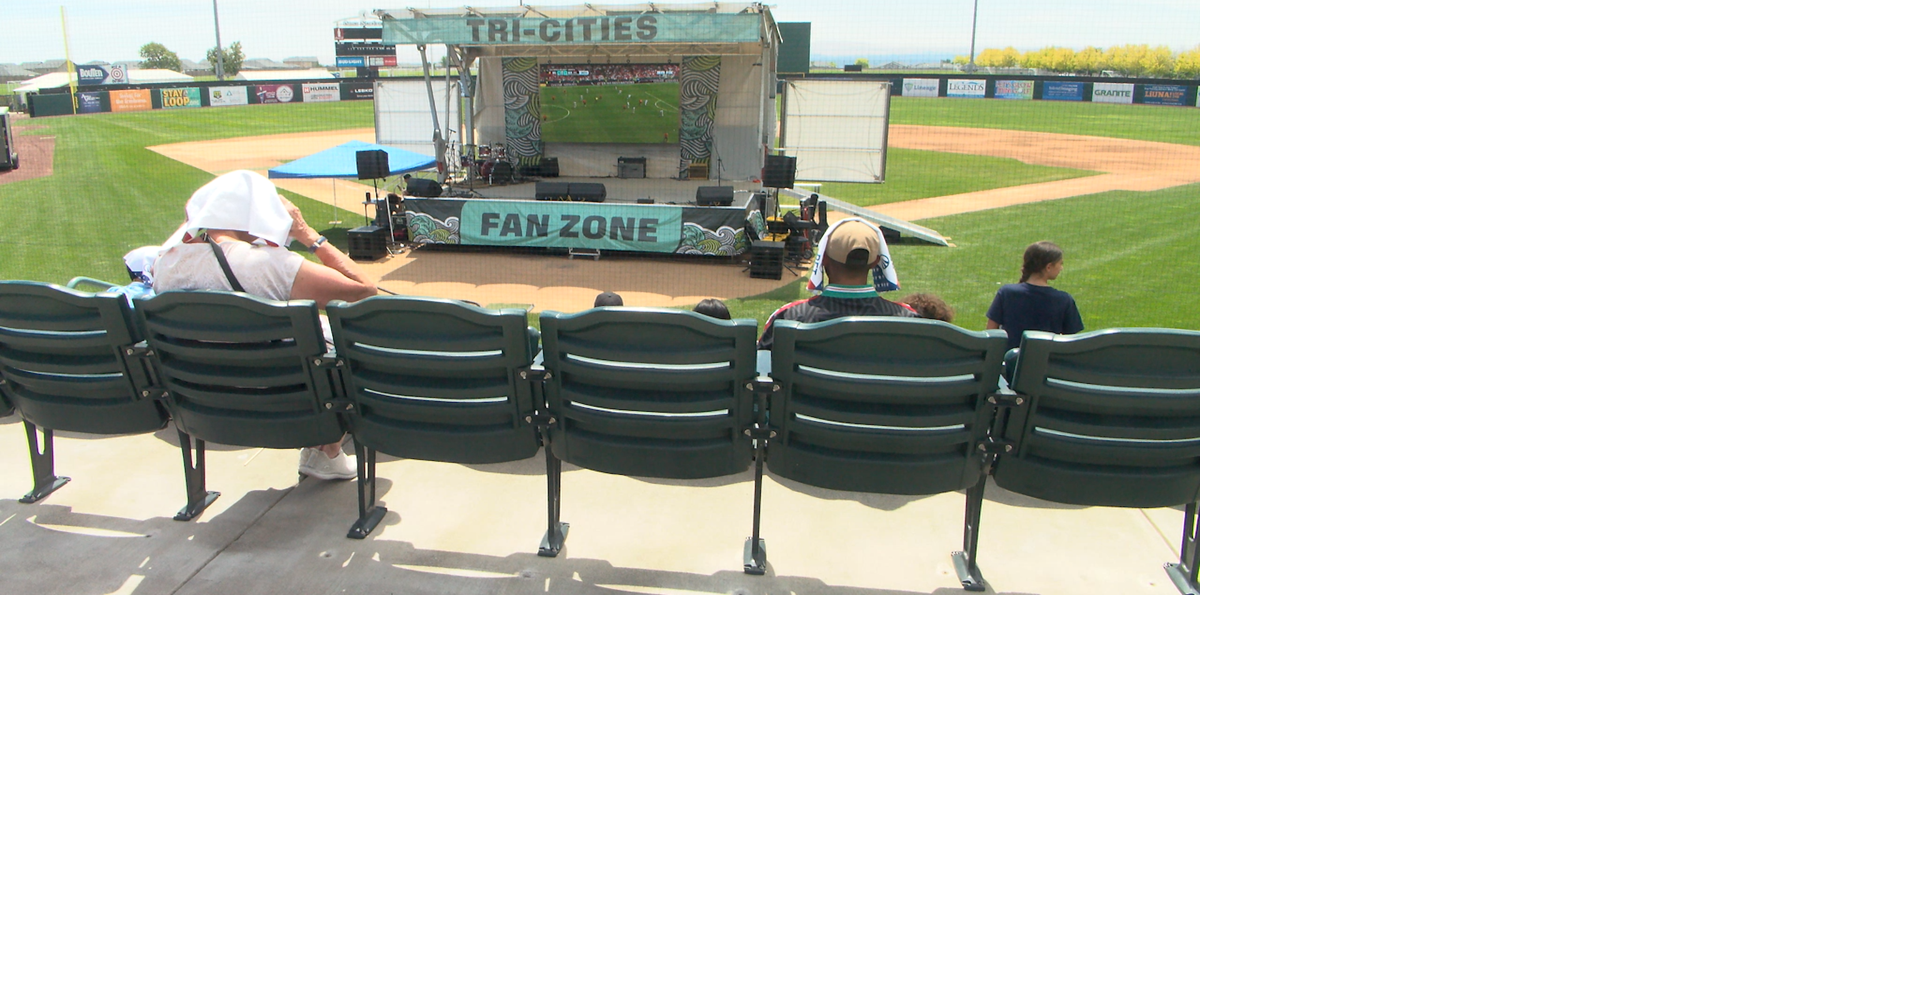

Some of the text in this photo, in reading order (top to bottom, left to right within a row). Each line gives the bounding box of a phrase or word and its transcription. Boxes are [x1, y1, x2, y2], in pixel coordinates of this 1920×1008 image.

[466, 15, 658, 42] TRI-CITIES
[949, 82, 984, 91] LEGENDS
[162, 89, 183, 97] STAY
[1094, 89, 1131, 97] GRANITE
[163, 96, 190, 107] LOOP
[480, 212, 659, 243] FAN ZONE
